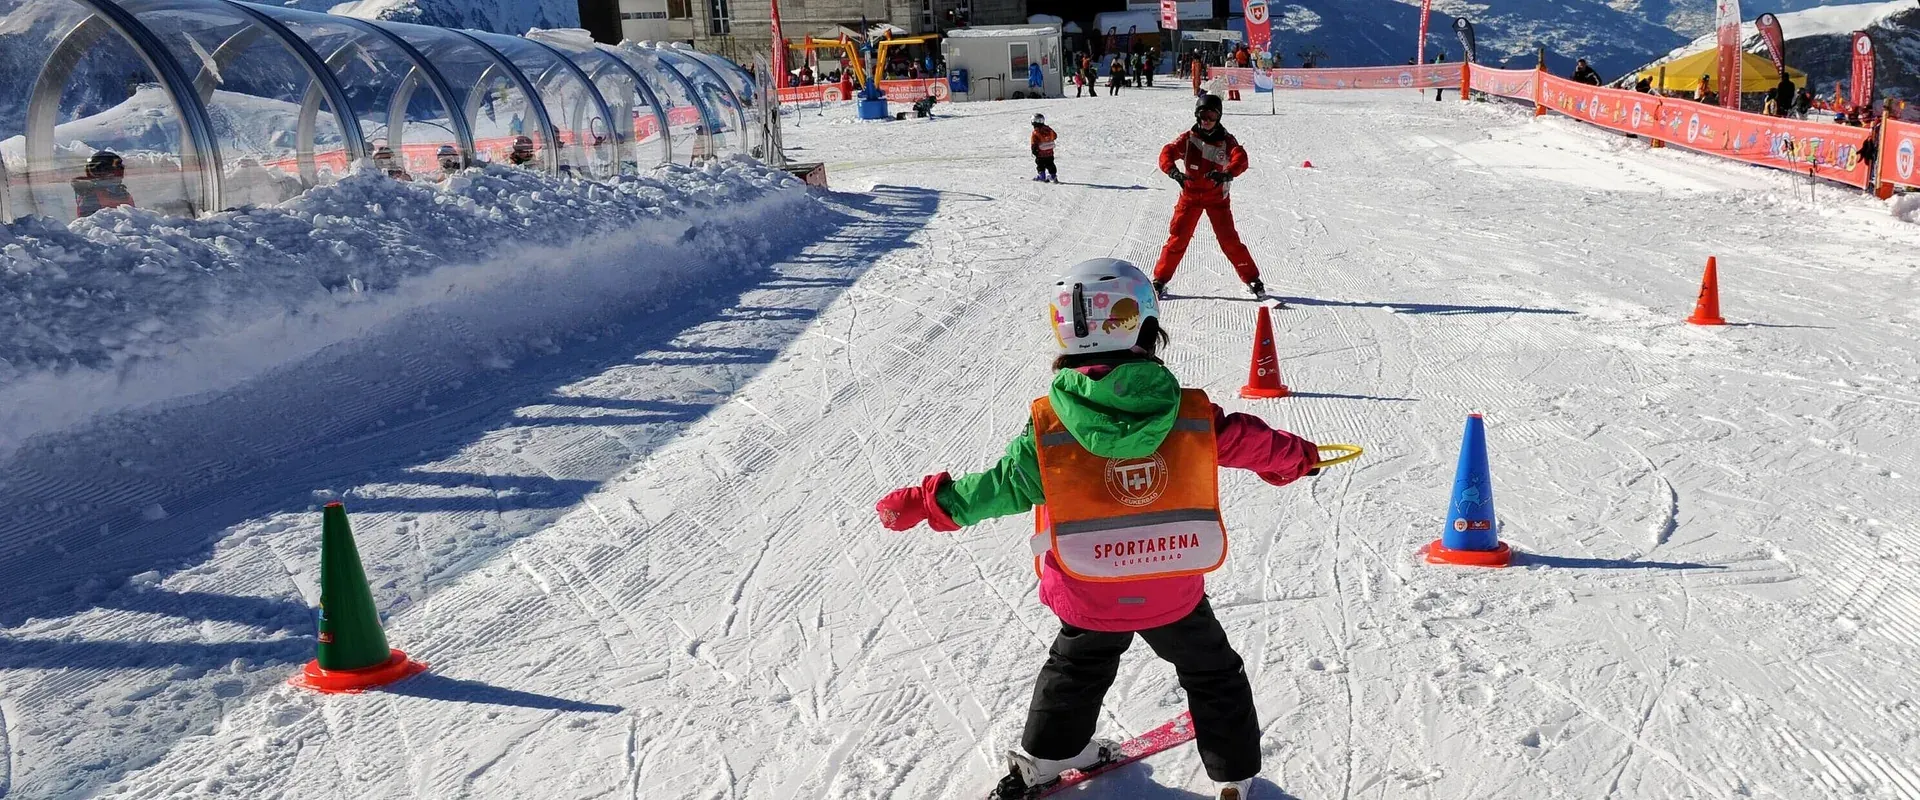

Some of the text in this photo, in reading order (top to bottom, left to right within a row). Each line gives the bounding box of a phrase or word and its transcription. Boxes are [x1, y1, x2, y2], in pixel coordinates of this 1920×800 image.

[1120, 492, 1158, 505] LEUKERBAD
[1094, 533, 1199, 559] SPORTARENA
[1114, 553, 1182, 567] LEUKERBAD
